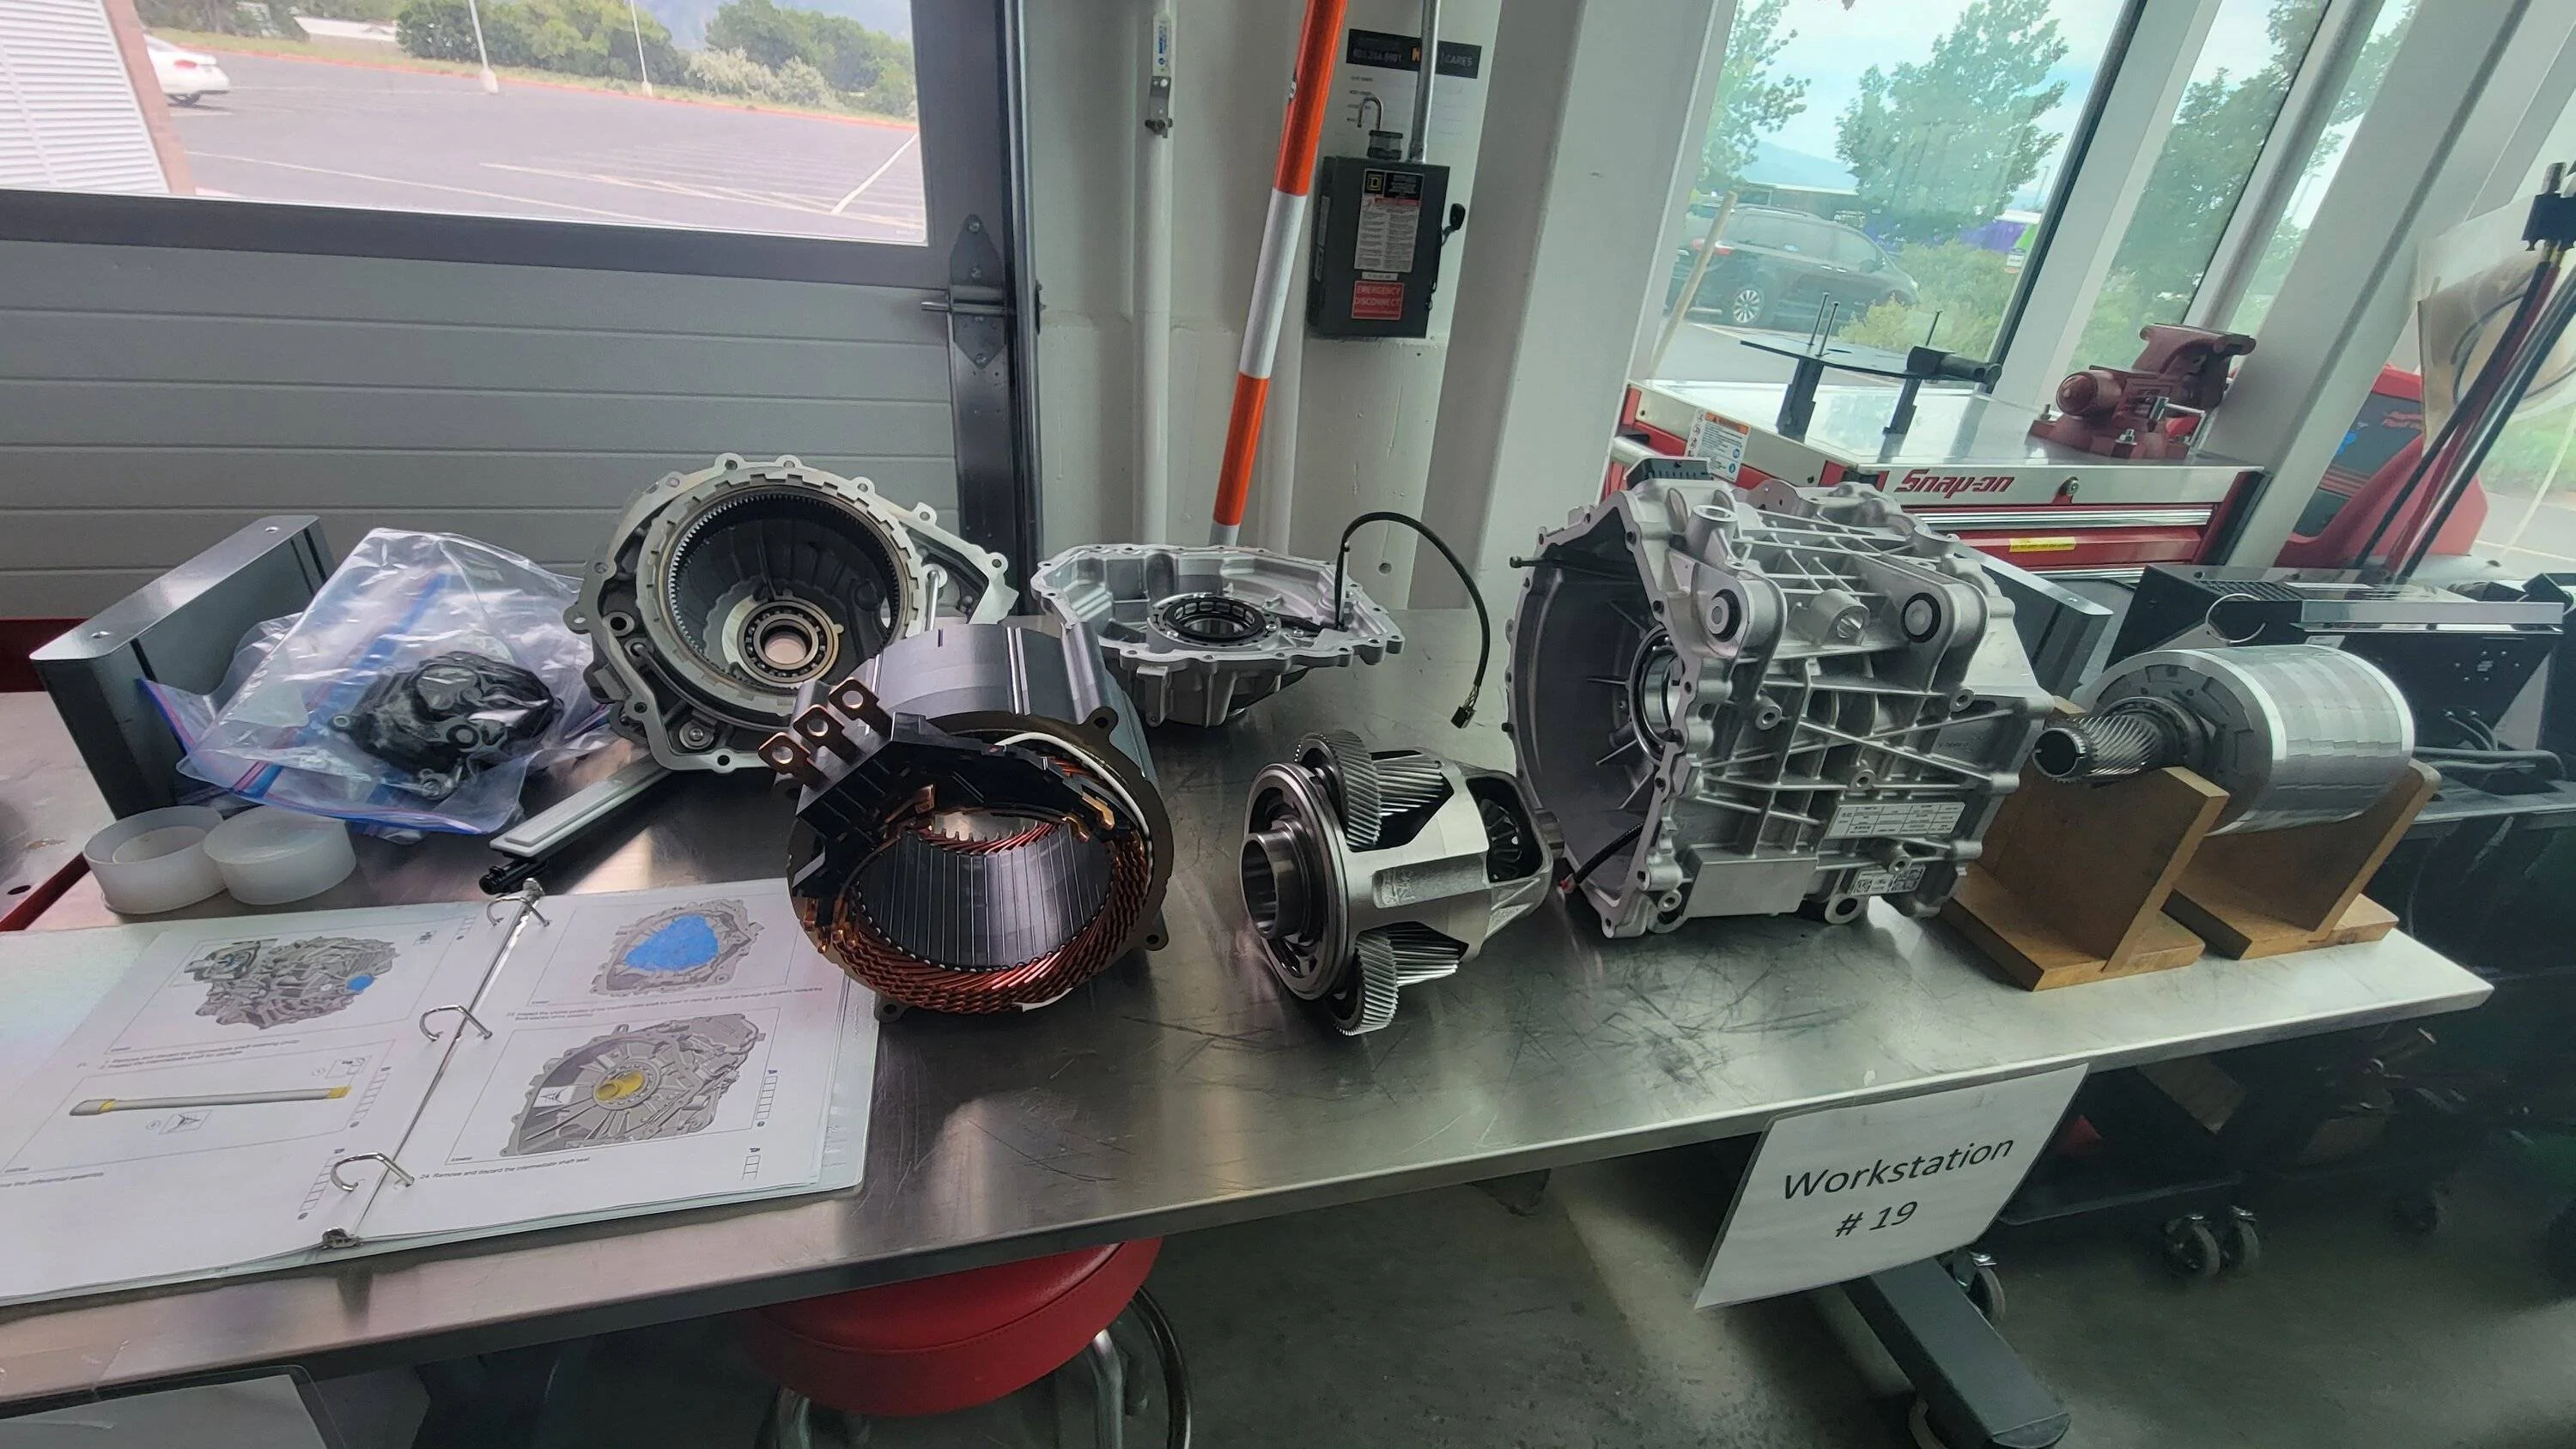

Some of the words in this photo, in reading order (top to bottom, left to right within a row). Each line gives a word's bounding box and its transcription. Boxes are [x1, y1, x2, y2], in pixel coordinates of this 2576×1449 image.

[1893, 469, 2015, 499] Snap-on
[1784, 1139, 2014, 1200] Workstation
[1835, 1212, 1863, 1238] #
[1869, 1201, 1917, 1232] 19
